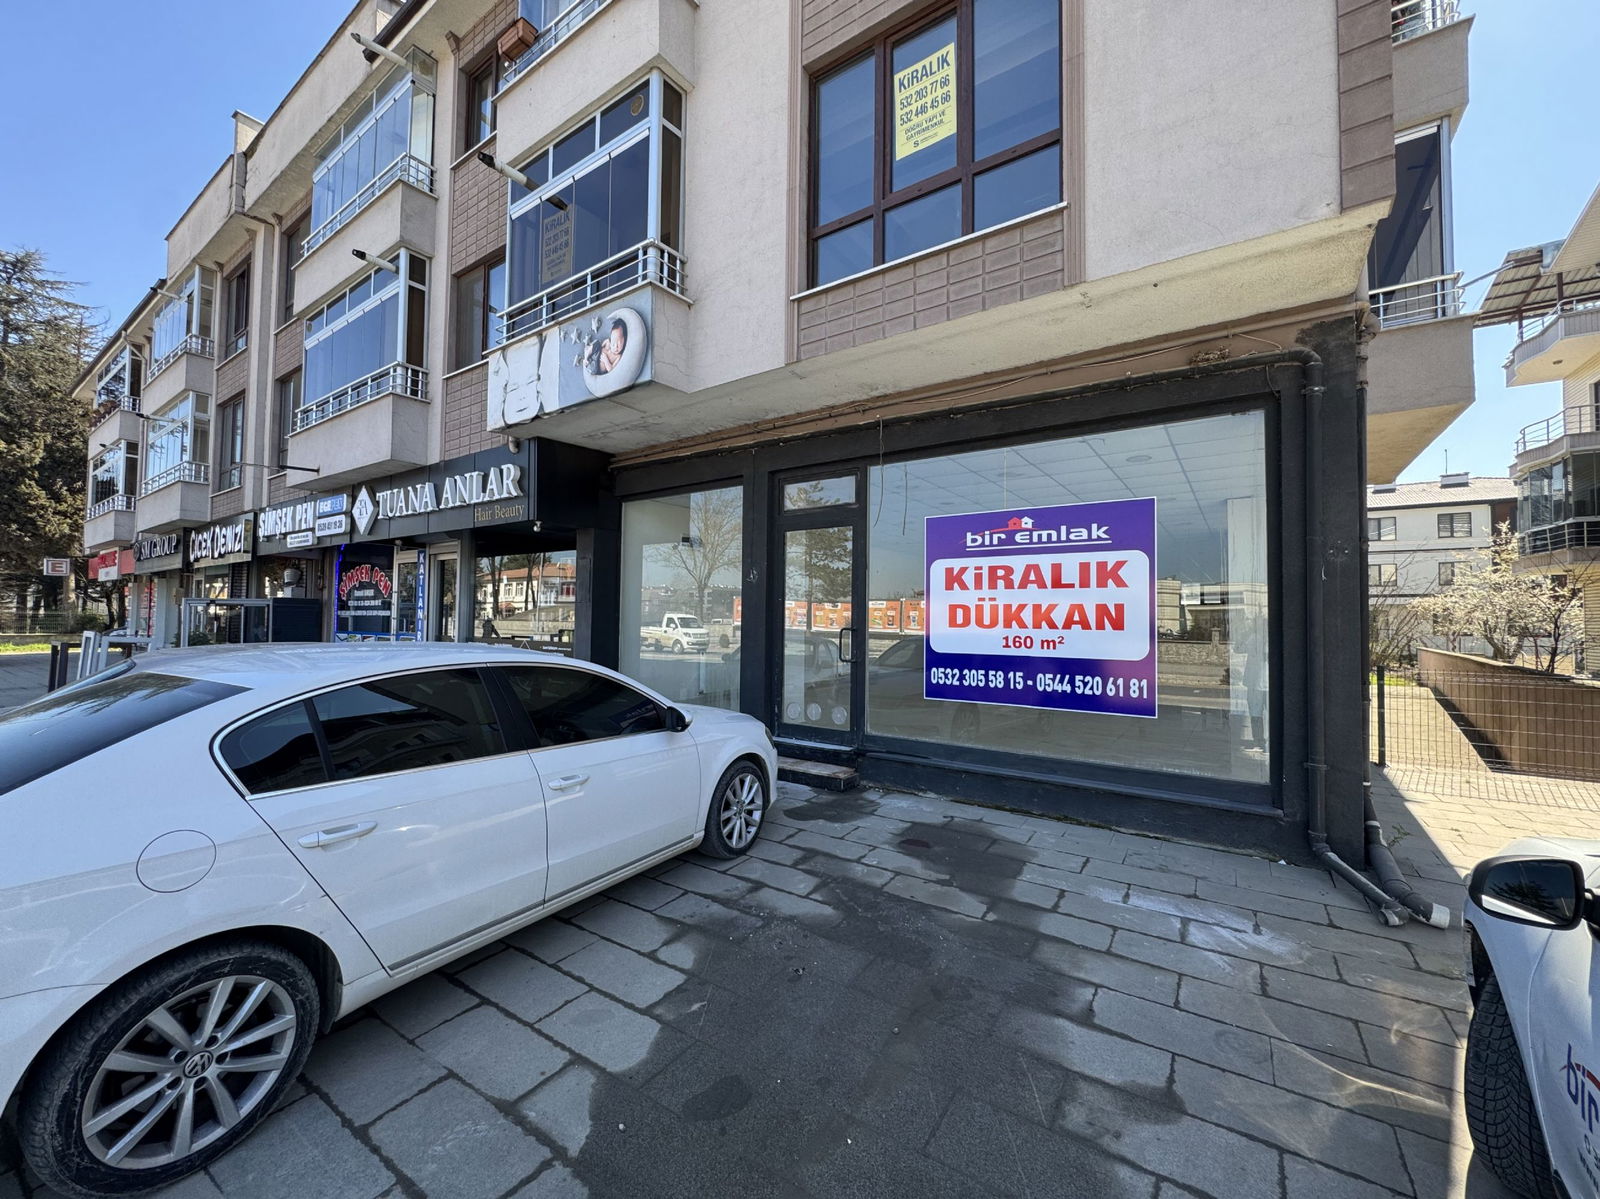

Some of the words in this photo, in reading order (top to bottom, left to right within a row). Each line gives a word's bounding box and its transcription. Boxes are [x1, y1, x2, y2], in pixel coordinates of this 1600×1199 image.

[900, 93, 913, 110] 532
[914, 86, 928, 103] 203
[930, 80, 938, 95] 77
[940, 74, 950, 90] 66
[900, 110, 913, 126] 532
[914, 101, 928, 118] 446
[930, 96, 940, 110] 45
[941, 90, 951, 105] 66
[376, 482, 439, 520] TUANA
[439, 463, 523, 509] ANLAR
[295, 501, 314, 531] PEN
[474, 507, 493, 522] Hair
[494, 504, 525, 520] Beauty
[151, 534, 177, 558] GROUP
[966, 531, 1006, 547] bir
[1015, 523, 1110, 543] emlak
[372, 567, 391, 598] PEN
[417, 553, 425, 641] KATLANIR
[948, 597, 1125, 631] DÜKKAN
[1002, 635, 1034, 649] 160
[931, 667, 960, 686] 0532
[962, 670, 985, 687] 305
[988, 671, 1004, 688] 58
[1008, 671, 1024, 690] 15
[1036, 673, 1072, 693] 0544
[1075, 676, 1102, 695] 520
[1106, 677, 1124, 697] 61
[1129, 679, 1147, 699] 81
